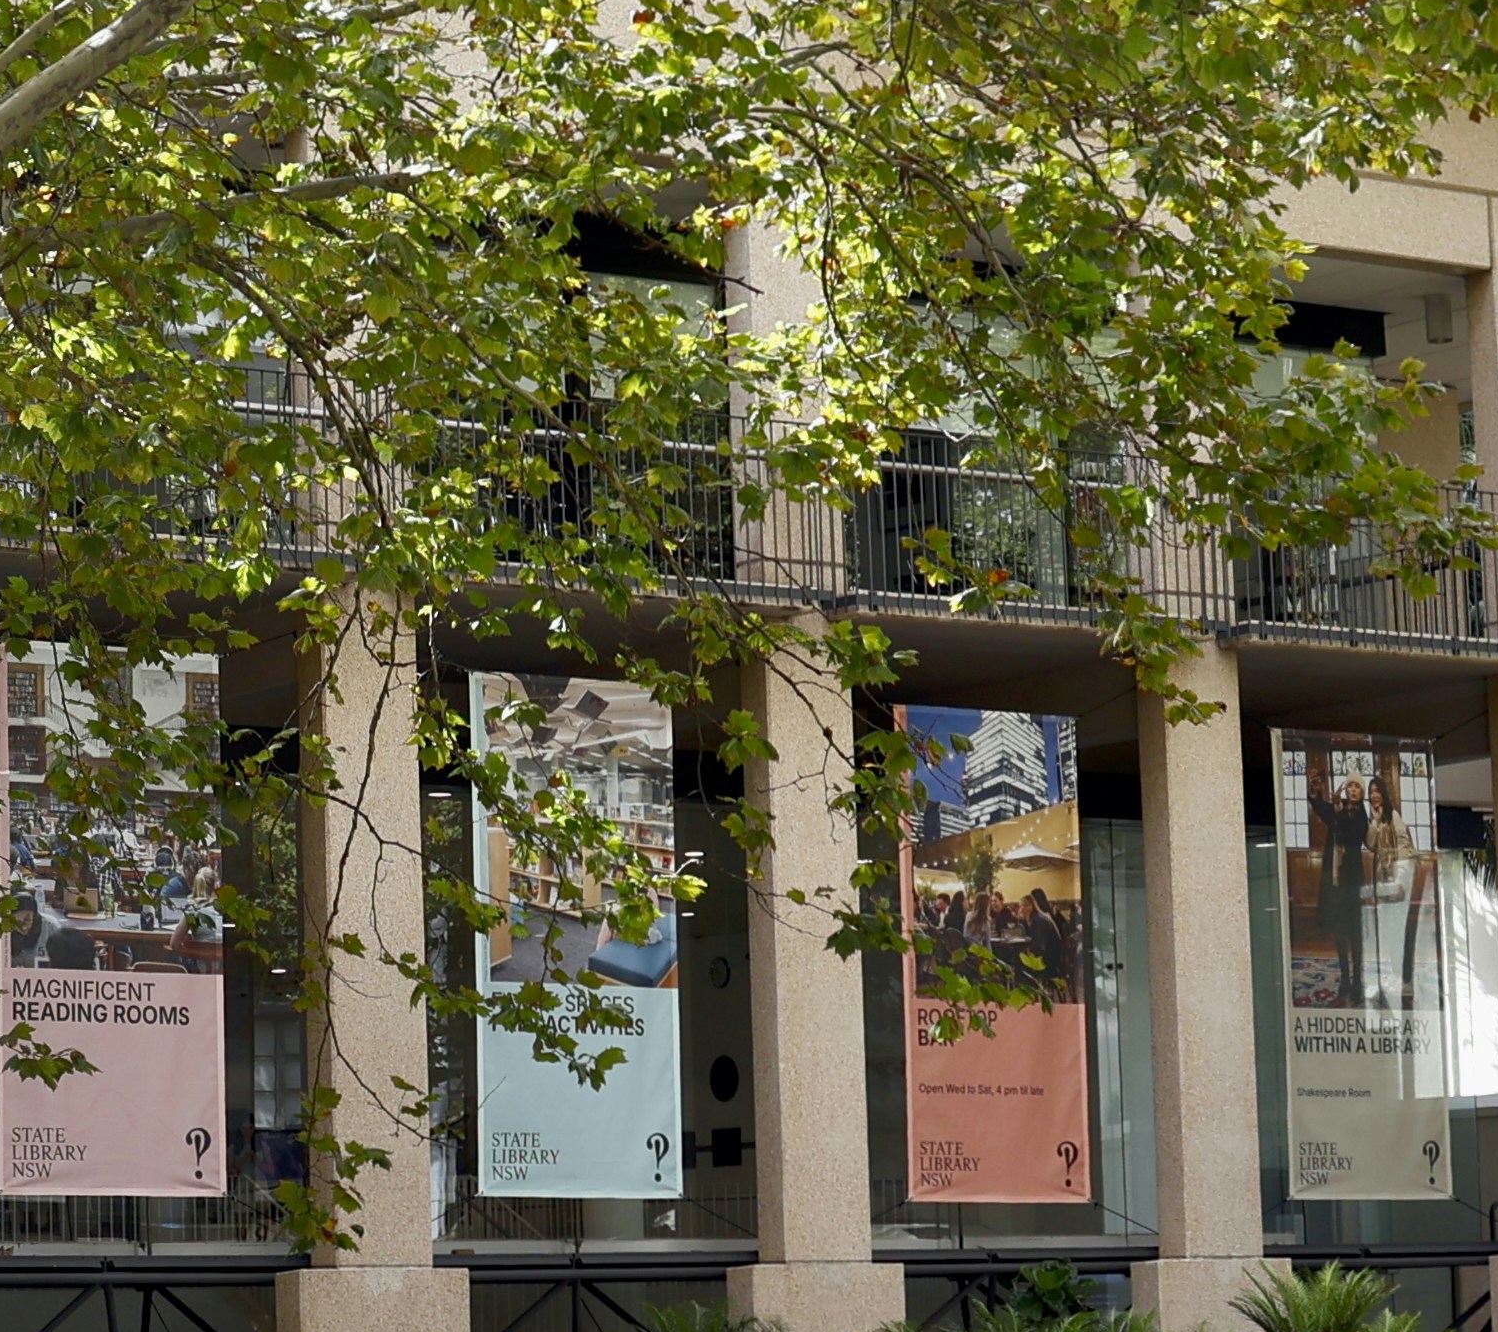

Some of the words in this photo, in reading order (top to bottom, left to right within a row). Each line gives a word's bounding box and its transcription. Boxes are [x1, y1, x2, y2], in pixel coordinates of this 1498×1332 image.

[12, 979, 155, 1001] MAGNIFICENT
[565, 994, 634, 1014] SPCES
[12, 1002, 107, 1023] READING
[114, 1005, 190, 1025] ROOMS
[1294, 1017, 1303, 1033] A
[1307, 1017, 1366, 1034] HIDDEN
[1371, 1019, 1429, 1035] LIBRARY
[1294, 1036, 1351, 1053] WITHIN
[1356, 1037, 1367, 1053] A
[1371, 1038, 1430, 1055] LIBRARY
[919, 1083, 944, 1095] Open
[945, 1084, 965, 1094] Wed
[968, 1084, 976, 1094] to
[977, 1084, 994, 1096] Sat,
[996, 1085, 1002, 1095] 4
[1004, 1087, 1018, 1096] pm
[1030, 1085, 1044, 1096] late
[1297, 1087, 1347, 1099] Shakespeare
[1348, 1088, 1371, 1098] Room
[12, 1127, 66, 1143] STATE
[492, 1132, 540, 1148] STATE
[12, 1144, 87, 1161] LIBRARY
[492, 1148, 560, 1164] LIBRARY
[920, 1141, 964, 1155] STATE
[1299, 1142, 1338, 1156] STATE
[12, 1162, 52, 1178] NSW
[920, 1157, 980, 1171] LIBRARY
[1300, 1157, 1353, 1171] LIBRARY
[492, 1166, 528, 1181] NSW
[920, 1173, 952, 1187] NSW
[1300, 1172, 1329, 1185] NSW
